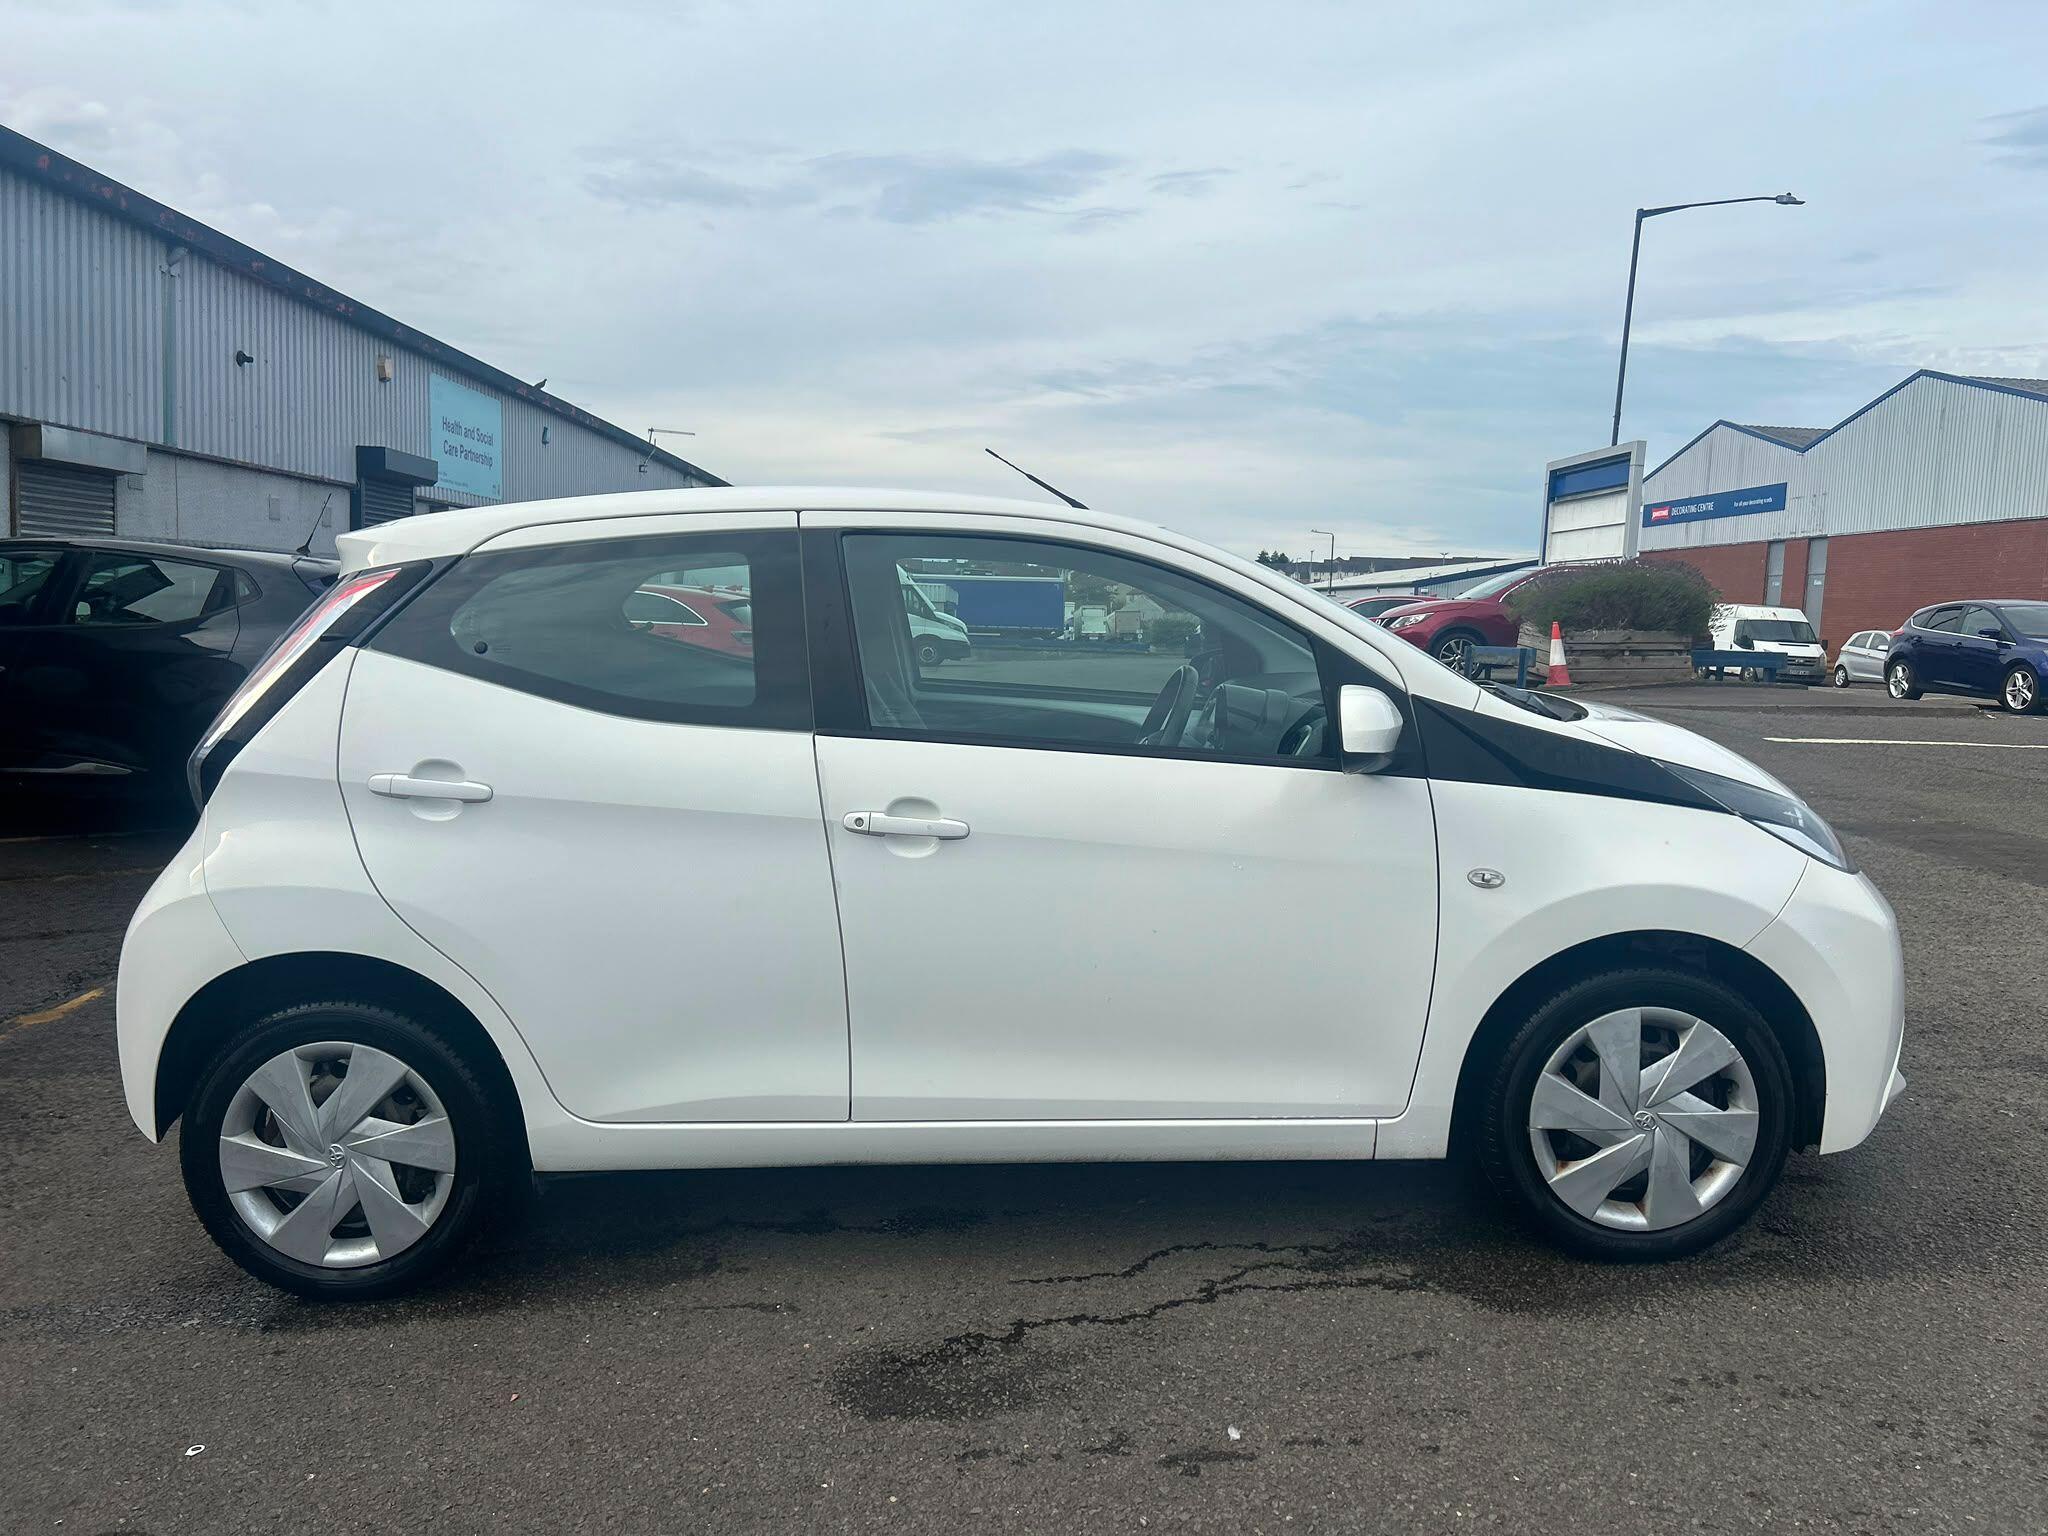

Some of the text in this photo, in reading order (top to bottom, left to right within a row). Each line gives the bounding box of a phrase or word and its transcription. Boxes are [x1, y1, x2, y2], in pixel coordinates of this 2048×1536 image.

[442, 416, 494, 447] Health and Social
[443, 440, 493, 470] Care Partnership
[1671, 504, 1697, 516] DECORATING
[1697, 502, 1714, 512] CENTRE
